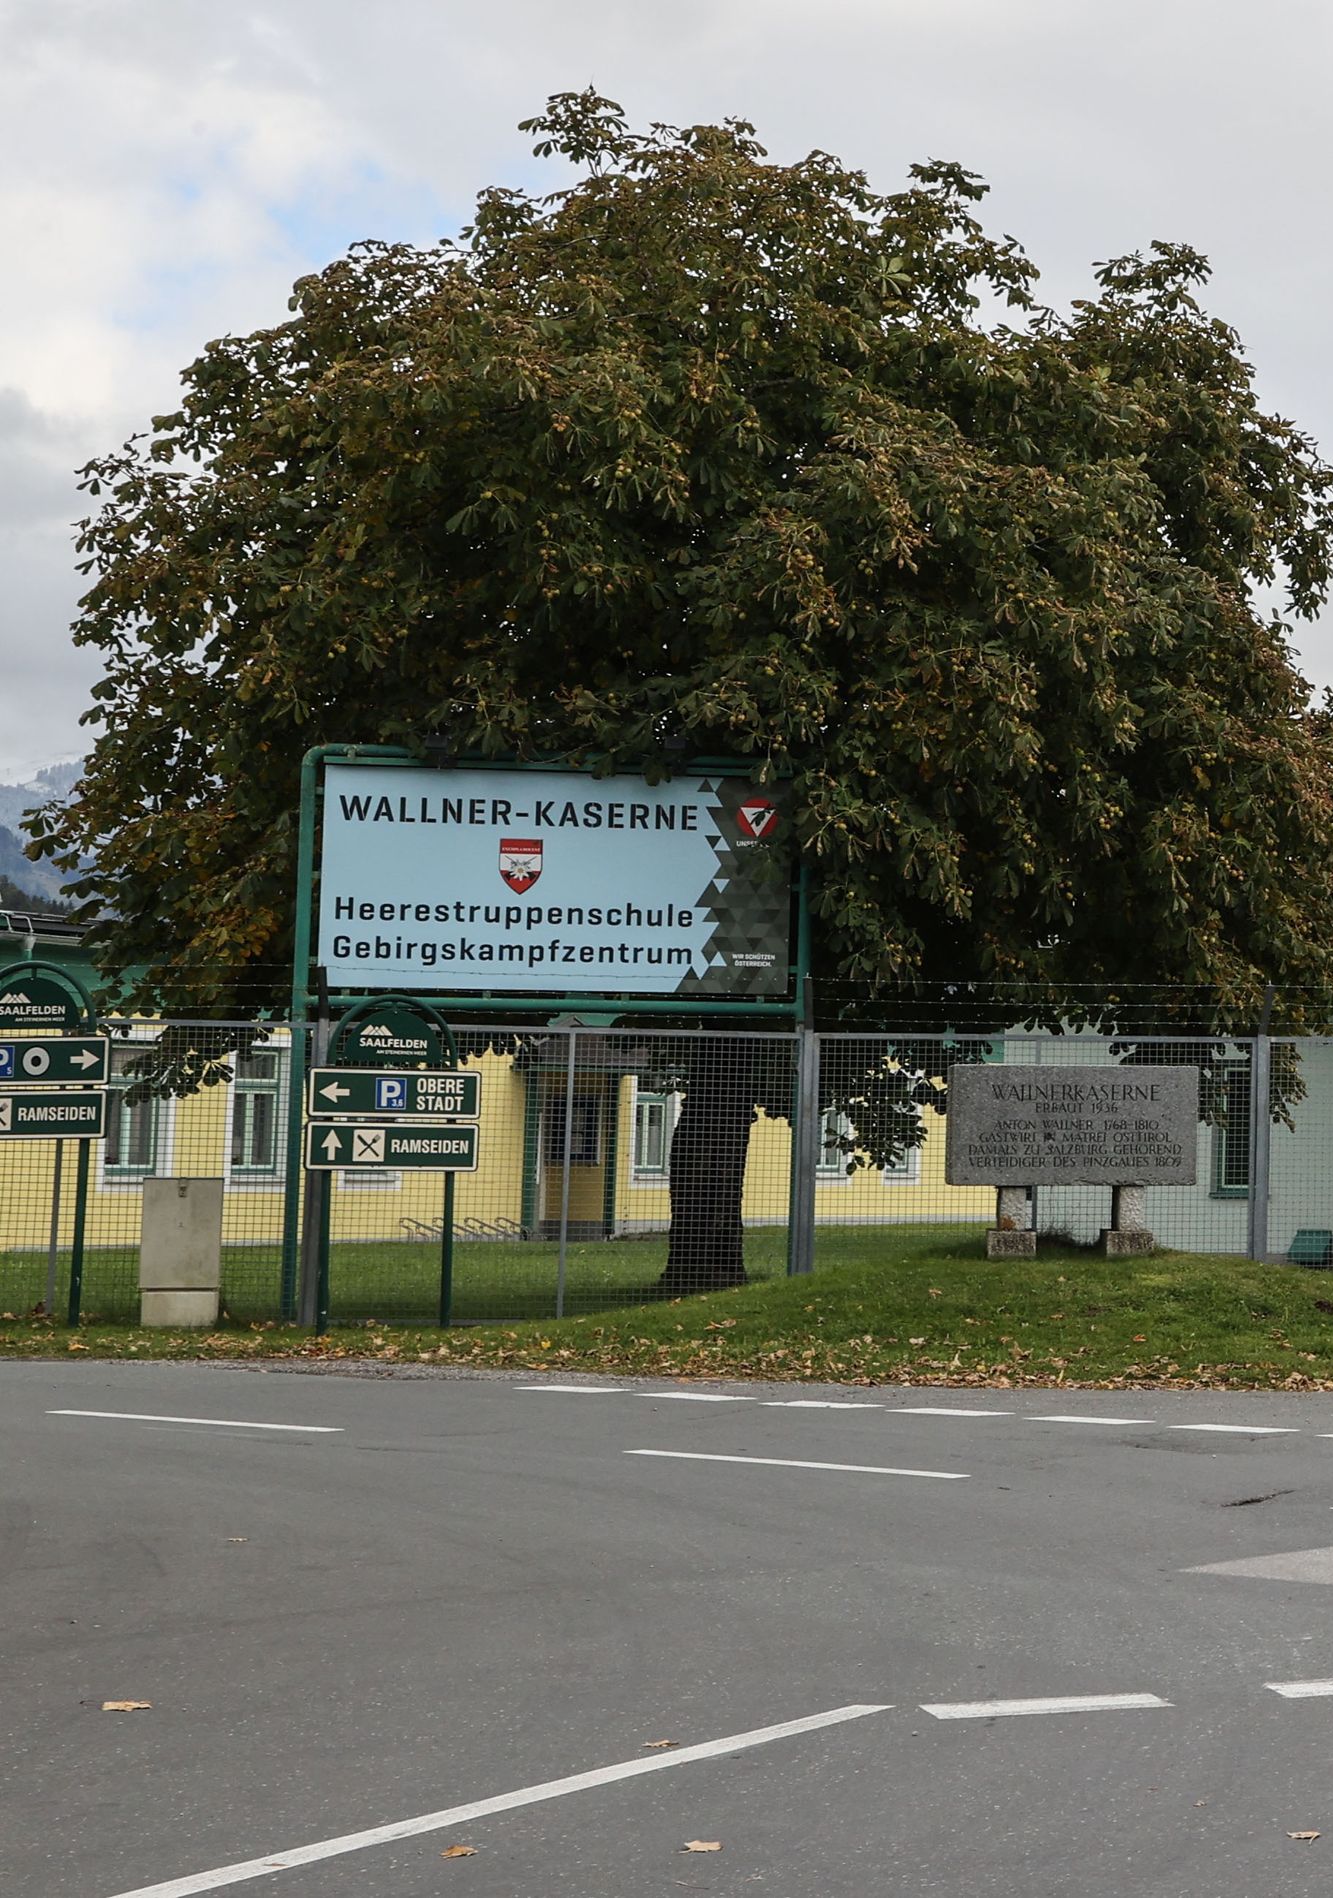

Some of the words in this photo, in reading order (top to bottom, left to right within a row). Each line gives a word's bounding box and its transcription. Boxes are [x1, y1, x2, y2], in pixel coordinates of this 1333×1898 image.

[339, 795, 698, 831] WALLNER-KASERNE
[334, 897, 694, 930] Heerestruppenschule
[332, 935, 693, 967] Gebirgskampfzentrum
[0, 1005, 66, 1016] SAALFELDEN
[359, 1037, 428, 1049] SAALFELDEN
[381, 1080, 401, 1107] P
[416, 1078, 465, 1094] OBERE
[416, 1096, 464, 1111] STADT
[1035, 1102, 1083, 1113] ERBAUT
[17, 1106, 96, 1122] RAMSEIDEN
[994, 1120, 1036, 1130] ANTON
[1062, 1132, 1107, 1142] MATREI
[1113, 1132, 1172, 1143] OSTTIROL
[390, 1138, 469, 1155] RAMSEIDEN
[1053, 1157, 1076, 1167] DES
